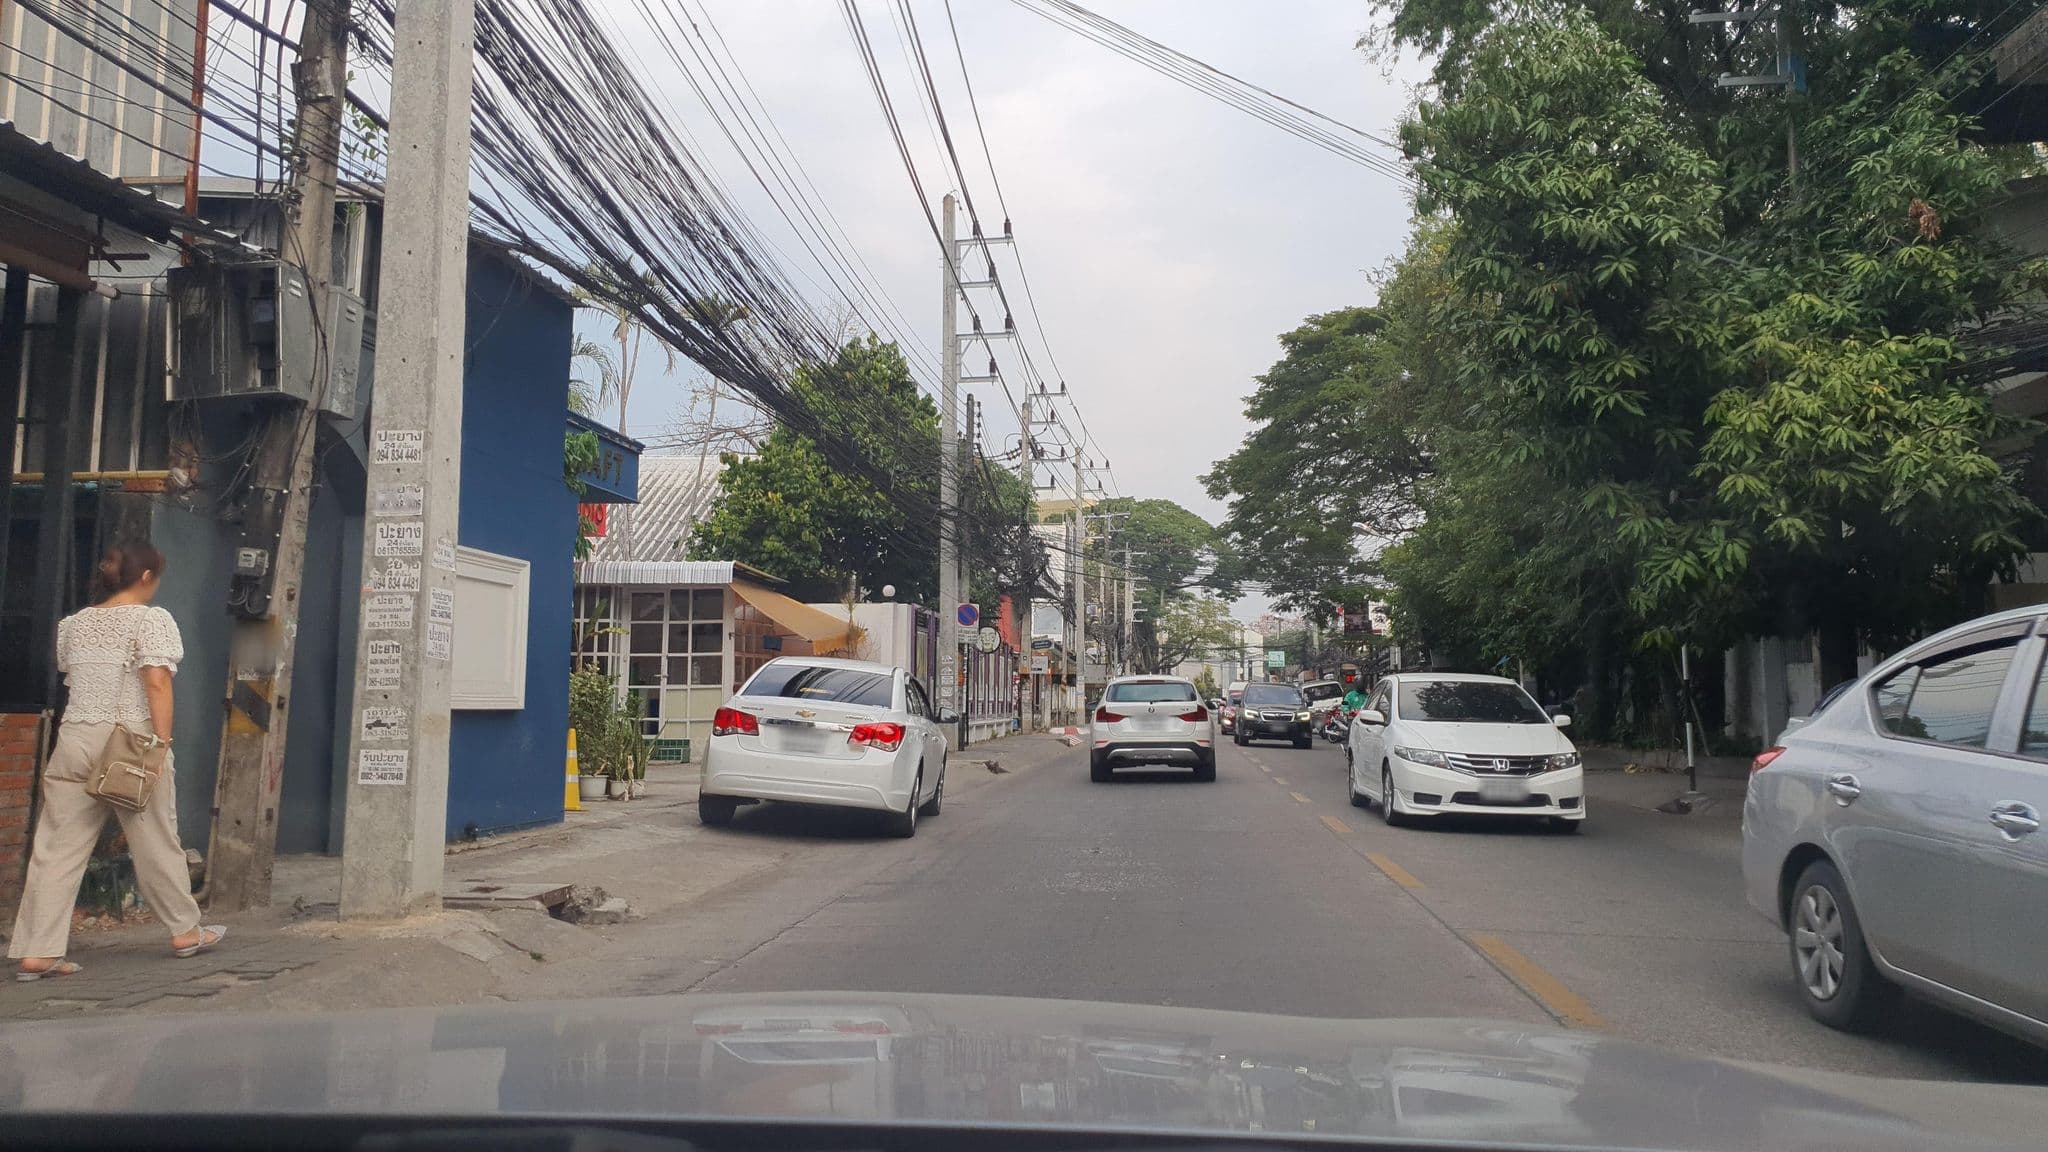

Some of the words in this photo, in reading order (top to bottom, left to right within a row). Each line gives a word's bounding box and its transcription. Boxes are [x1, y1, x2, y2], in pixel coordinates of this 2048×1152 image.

[377, 431, 422, 442] ปะยาง
[379, 525, 421, 539] ปะยาง
[387, 539, 398, 547] 24
[377, 594, 403, 605] ปะยาง
[370, 643, 401, 654] ปะยาง
[363, 751, 404, 762] รับปะยาง
